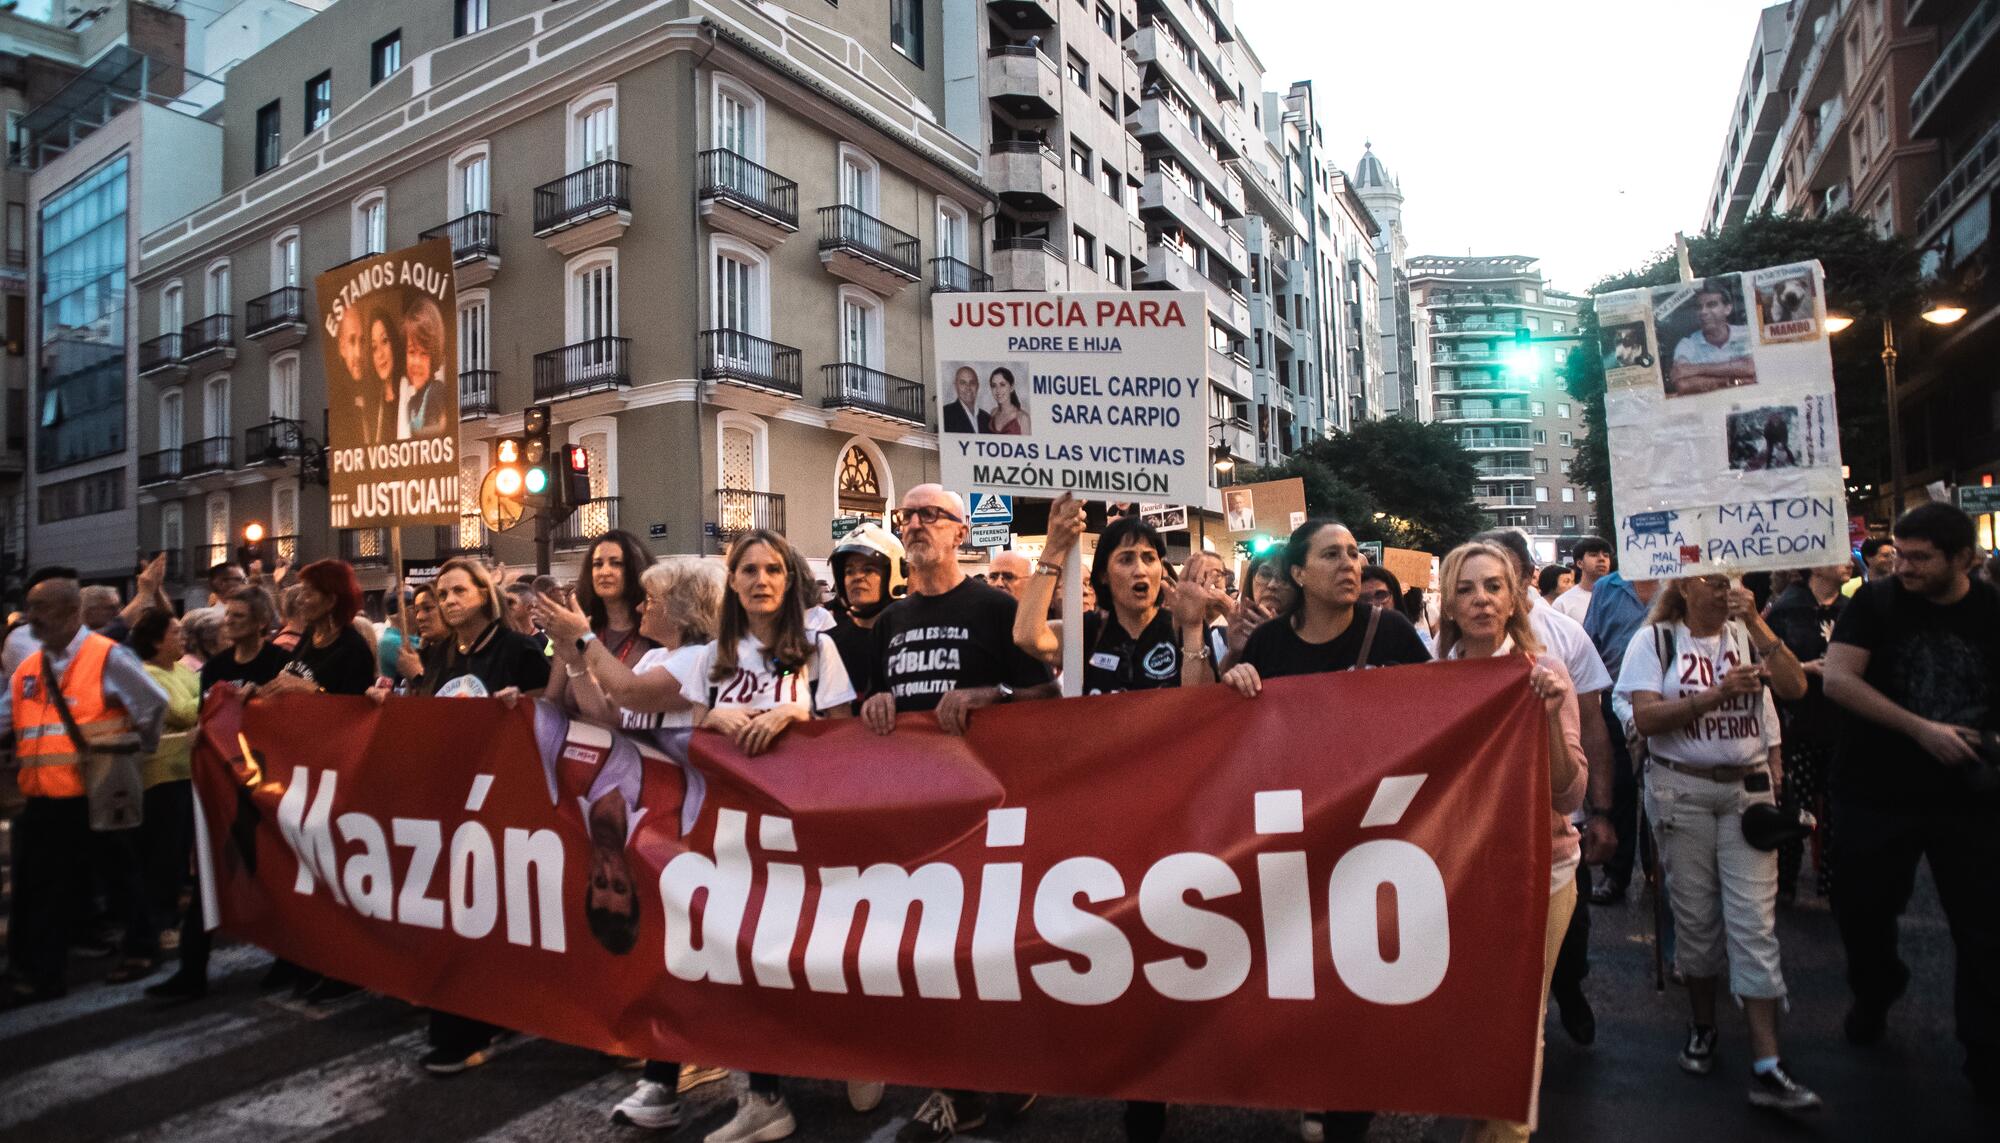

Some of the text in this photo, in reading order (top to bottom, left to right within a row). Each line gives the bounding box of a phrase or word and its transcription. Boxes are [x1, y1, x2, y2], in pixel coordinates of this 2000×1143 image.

[325, 260, 449, 338] ESTAMOS AQUÍ
[1096, 300, 1186, 327] PARA
[1769, 322, 1810, 338] MAMBO
[1008, 336, 1122, 351] PADRE E HIJA
[1033, 375, 1200, 398] MIGUEL CARPIO Y
[1051, 404, 1180, 427] SARA CARPIO
[334, 436, 454, 474] POR VOSOTROS
[958, 441, 1185, 466] Y TODAS LAS VICTIMAS
[973, 462, 1169, 493] MAZÓN DIMISIÓN
[972, 528, 1008, 536] PREFERENCIA
[1751, 521, 1779, 535] AL
[1626, 531, 1686, 552] RATA
[1652, 551, 1677, 563] MAL
[409, 565, 441, 576] MAZÓ
[926, 626, 969, 640] ESCOLA
[887, 646, 961, 677] PÚBLICA
[905, 679, 958, 698] QUALITAT
[276, 765, 1451, 1006] Mazón dimissió
